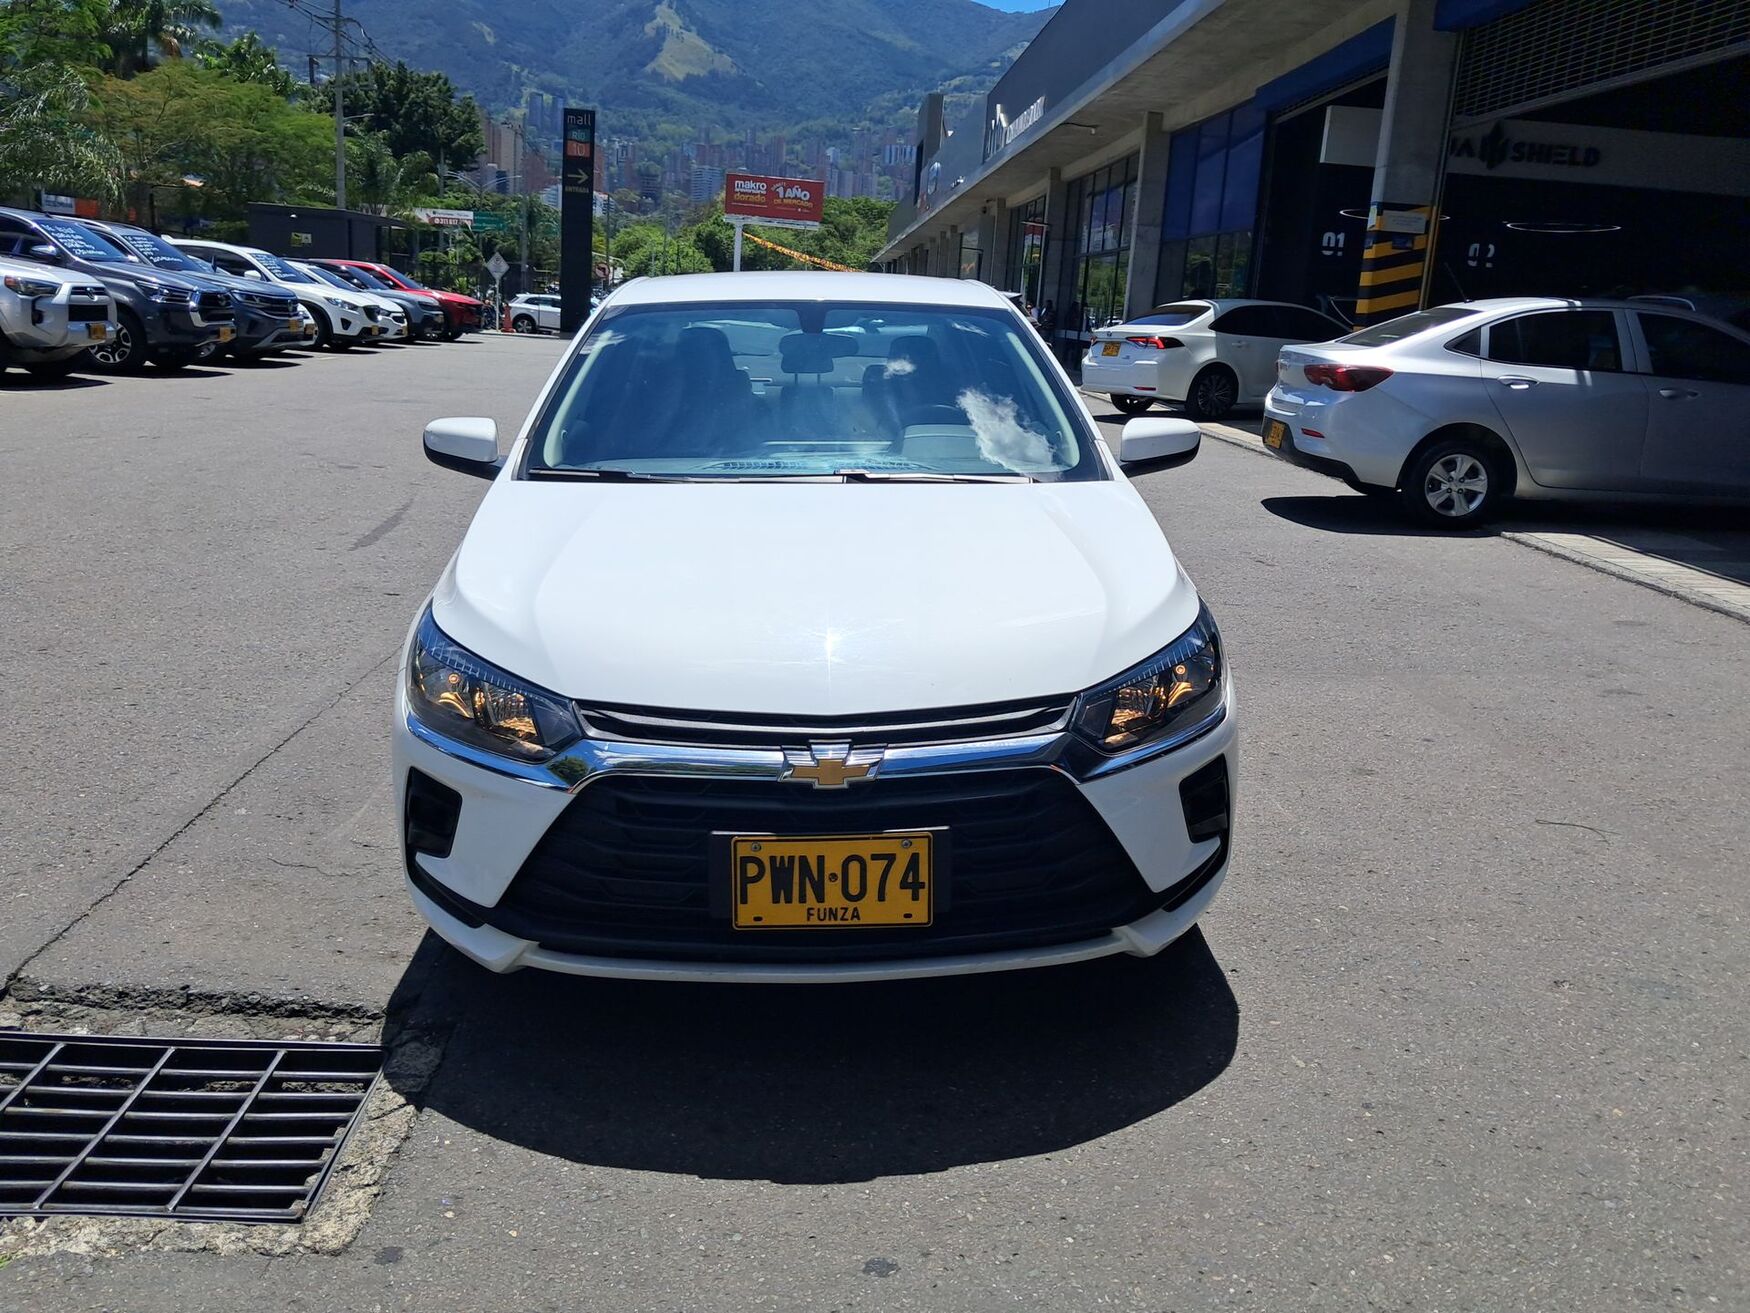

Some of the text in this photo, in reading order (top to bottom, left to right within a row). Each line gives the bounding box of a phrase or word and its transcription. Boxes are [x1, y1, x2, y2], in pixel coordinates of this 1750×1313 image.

[567, 113, 591, 126] mall
[1510, 141, 1600, 166] SHIELD
[734, 180, 767, 190] makro
[776, 185, 810, 201] 1 AÑO
[1321, 231, 1345, 256] 01
[807, 907, 860, 921] FUNZA
